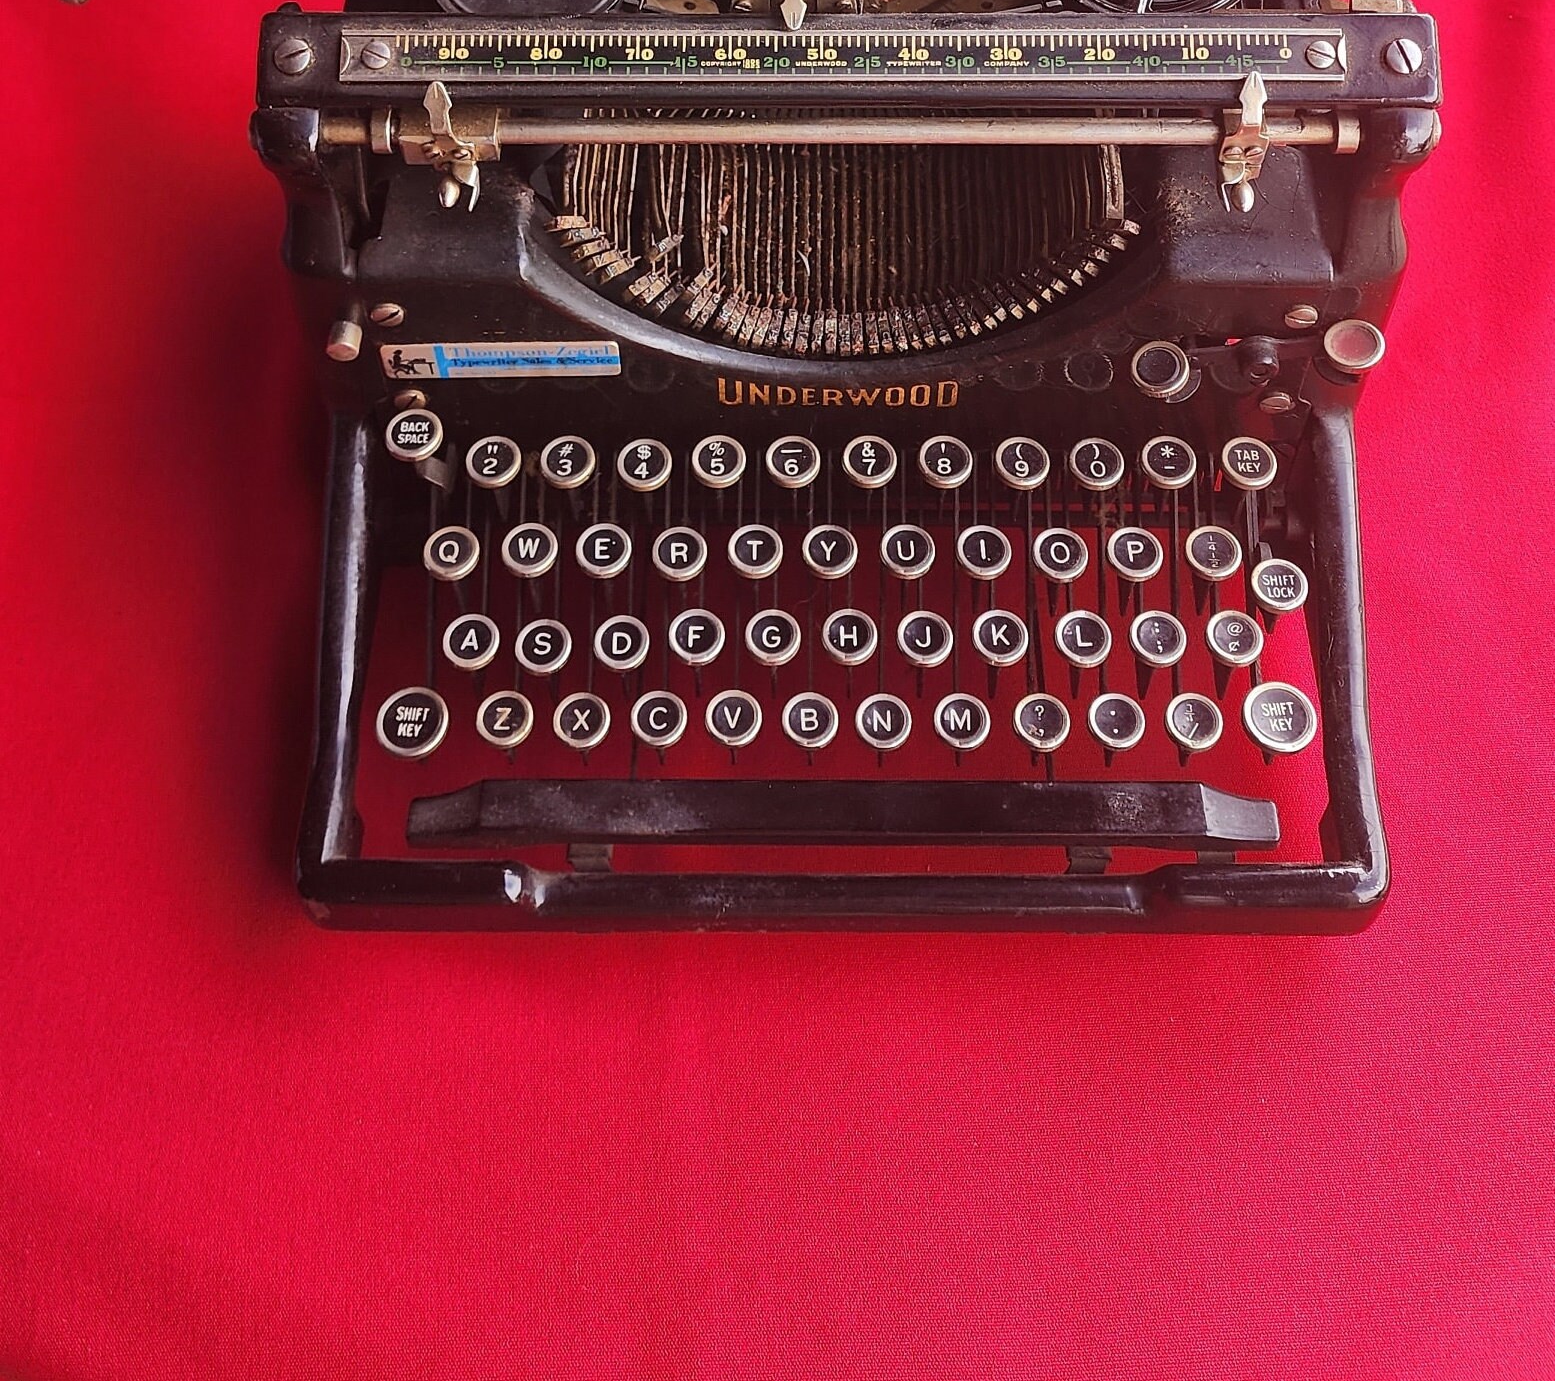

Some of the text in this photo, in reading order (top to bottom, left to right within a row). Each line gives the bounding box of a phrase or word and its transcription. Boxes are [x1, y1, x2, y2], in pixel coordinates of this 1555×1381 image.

[450, 357, 519, 367] Typewriter
[521, 356, 551, 365] Sales
[717, 377, 959, 408] UNDERWOOD
[400, 421, 430, 433] BACK
[396, 433, 430, 446] SPACE
[708, 441, 725, 457] %
[557, 443, 574, 458] #
[636, 444, 652, 461] $
[861, 441, 876, 458] &
[1015, 443, 1023, 460] (
[1091, 443, 1100, 460] )
[1233, 449, 1260, 461] TAB
[482, 457, 498, 475] 2
[556, 458, 573, 476] 3
[633, 462, 650, 480] 4
[708, 458, 725, 476] 5
[783, 458, 799, 476] 6
[861, 458, 877, 476] 7
[936, 457, 952, 475] 8
[1013, 461, 1030, 478] 9
[1237, 461, 1261, 473] KEY
[438, 540, 460, 564] Q
[518, 537, 541, 559] W
[594, 537, 611, 560] E
[670, 542, 688, 564] R
[746, 540, 764, 561] T
[820, 540, 837, 562] Y
[896, 540, 915, 561] U
[979, 538, 986, 561] I
[1050, 541, 1071, 564] O
[1126, 540, 1144, 563] P
[1260, 574, 1295, 587] SHIFT
[1266, 586, 1296, 600] LOCK
[687, 625, 705, 648] F
[761, 625, 781, 648] G
[839, 624, 858, 647] H
[915, 625, 931, 648] J
[991, 623, 1011, 646] K
[1075, 624, 1093, 647] L
[1226, 621, 1244, 638] @
[460, 628, 479, 651] A
[533, 632, 552, 656] S
[611, 631, 632, 655] D
[395, 705, 430, 722] SHIFT
[493, 707, 512, 731] Z
[648, 706, 668, 730] C
[723, 705, 742, 729] V
[948, 706, 971, 731] M
[1034, 704, 1045, 721] ?
[1260, 701, 1295, 718] SHIFT
[572, 708, 591, 731] X
[800, 708, 819, 732] B
[872, 707, 892, 732] N
[1268, 717, 1294, 733] KEY
[397, 722, 423, 738] KEY
